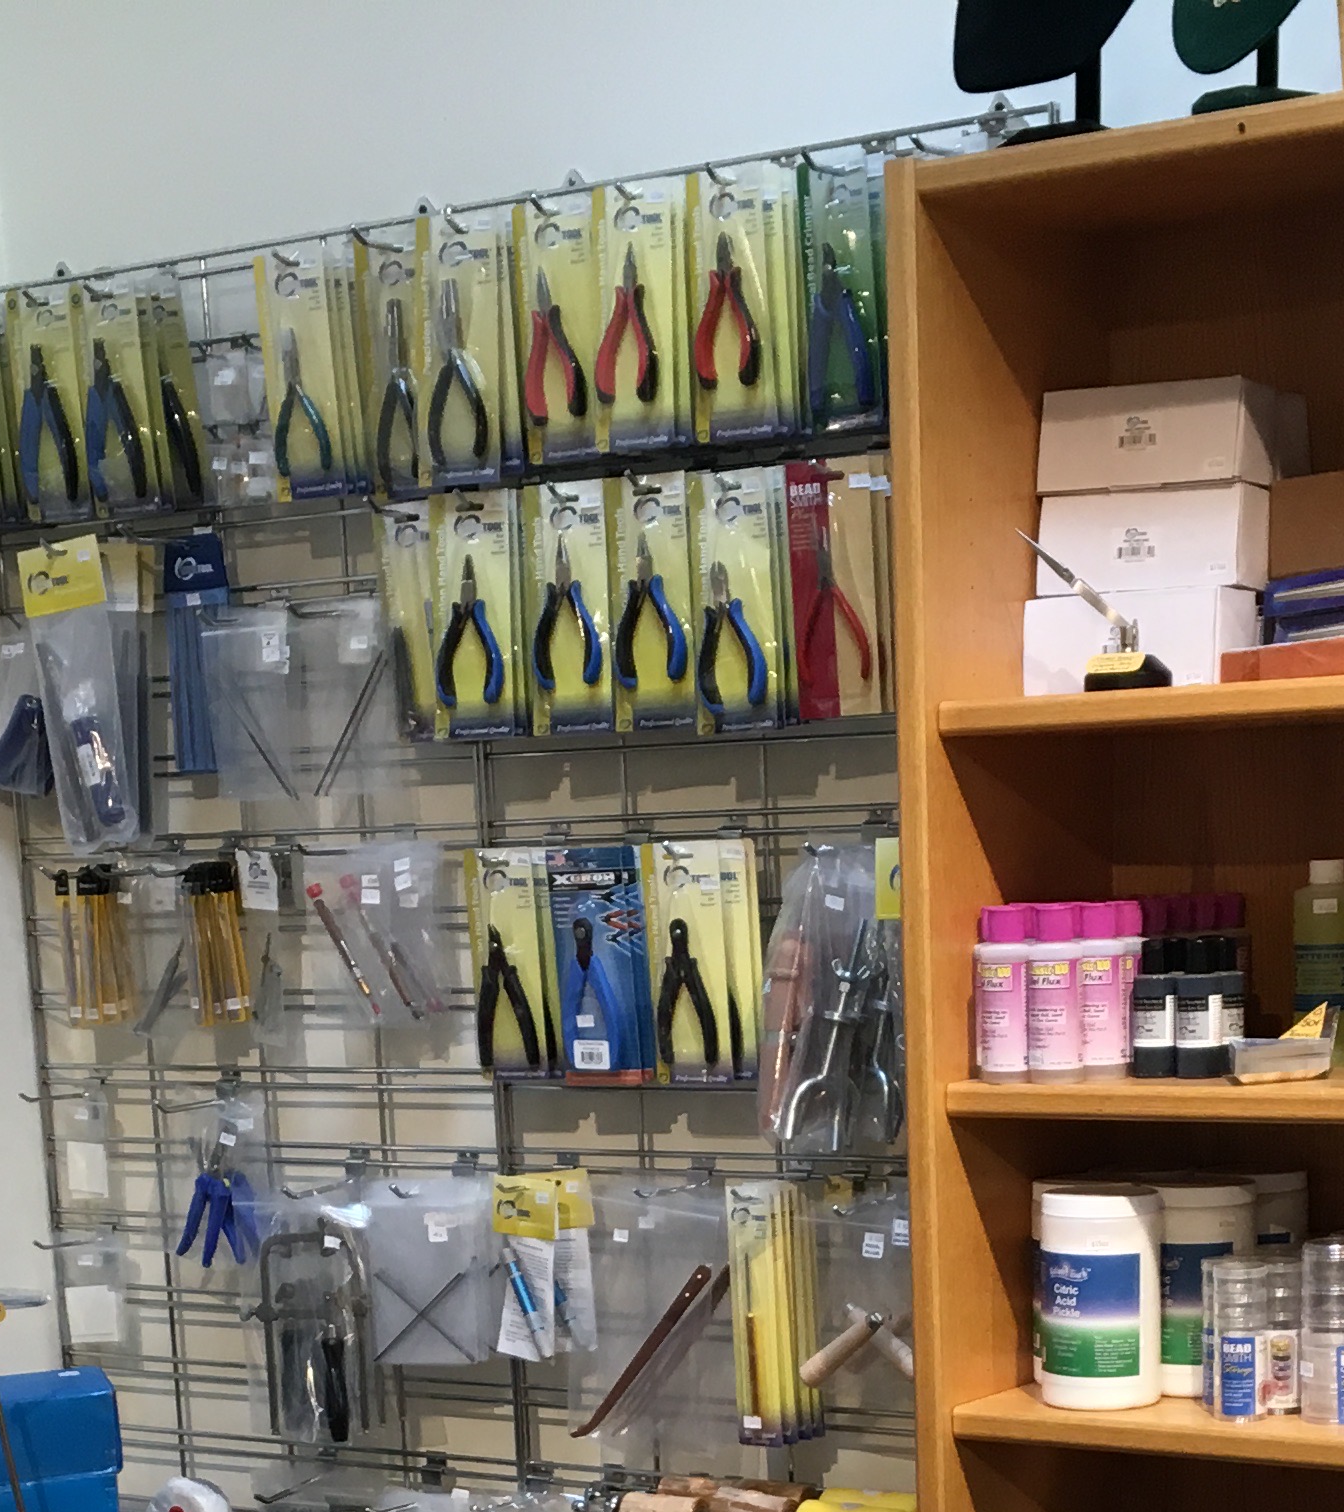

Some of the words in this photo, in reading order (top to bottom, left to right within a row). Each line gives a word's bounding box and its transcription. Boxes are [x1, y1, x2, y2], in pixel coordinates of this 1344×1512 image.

[789, 482, 821, 496] BEAD
[578, 513, 601, 525] TOOL
[482, 521, 504, 533] TOOL
[1041, 977, 1061, 986] Flux
[1084, 973, 1104, 981] Flux
[1053, 1283, 1079, 1295] Citric
[1055, 1295, 1077, 1306] Acid
[1052, 1307, 1081, 1318] Pickle
[1222, 1343, 1252, 1354] BEAD
[1222, 1352, 1253, 1363] SMITH
